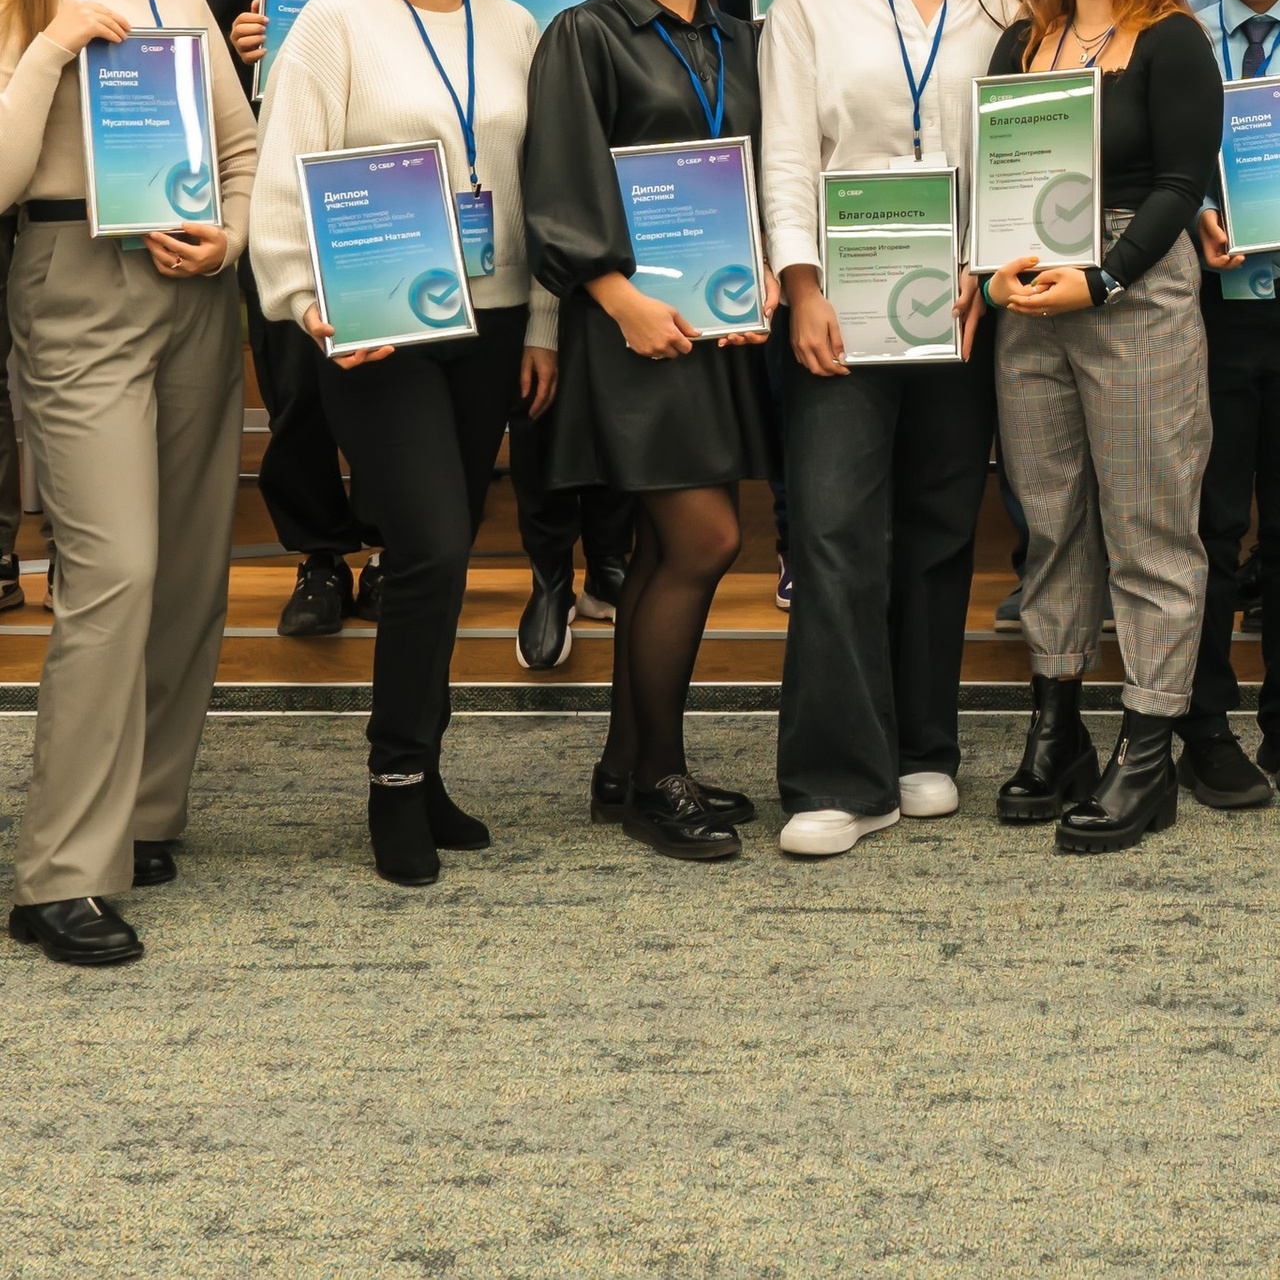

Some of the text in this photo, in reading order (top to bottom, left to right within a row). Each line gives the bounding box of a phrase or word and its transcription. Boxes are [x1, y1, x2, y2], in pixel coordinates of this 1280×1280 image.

[99, 69, 138, 79] Диплом
[990, 113, 1069, 126] Благодарность
[1231, 114, 1271, 125] Диплом
[1232, 121, 1271, 133] участника
[632, 184, 674, 196] Диплом
[324, 190, 368, 203] Диплом
[632, 193, 674, 204] участника
[326, 198, 369, 210] участника
[839, 209, 925, 220] Благодарность
[331, 230, 421, 248] Колоярцева Наталия
[635, 228, 703, 241] Севрюгина Вера
